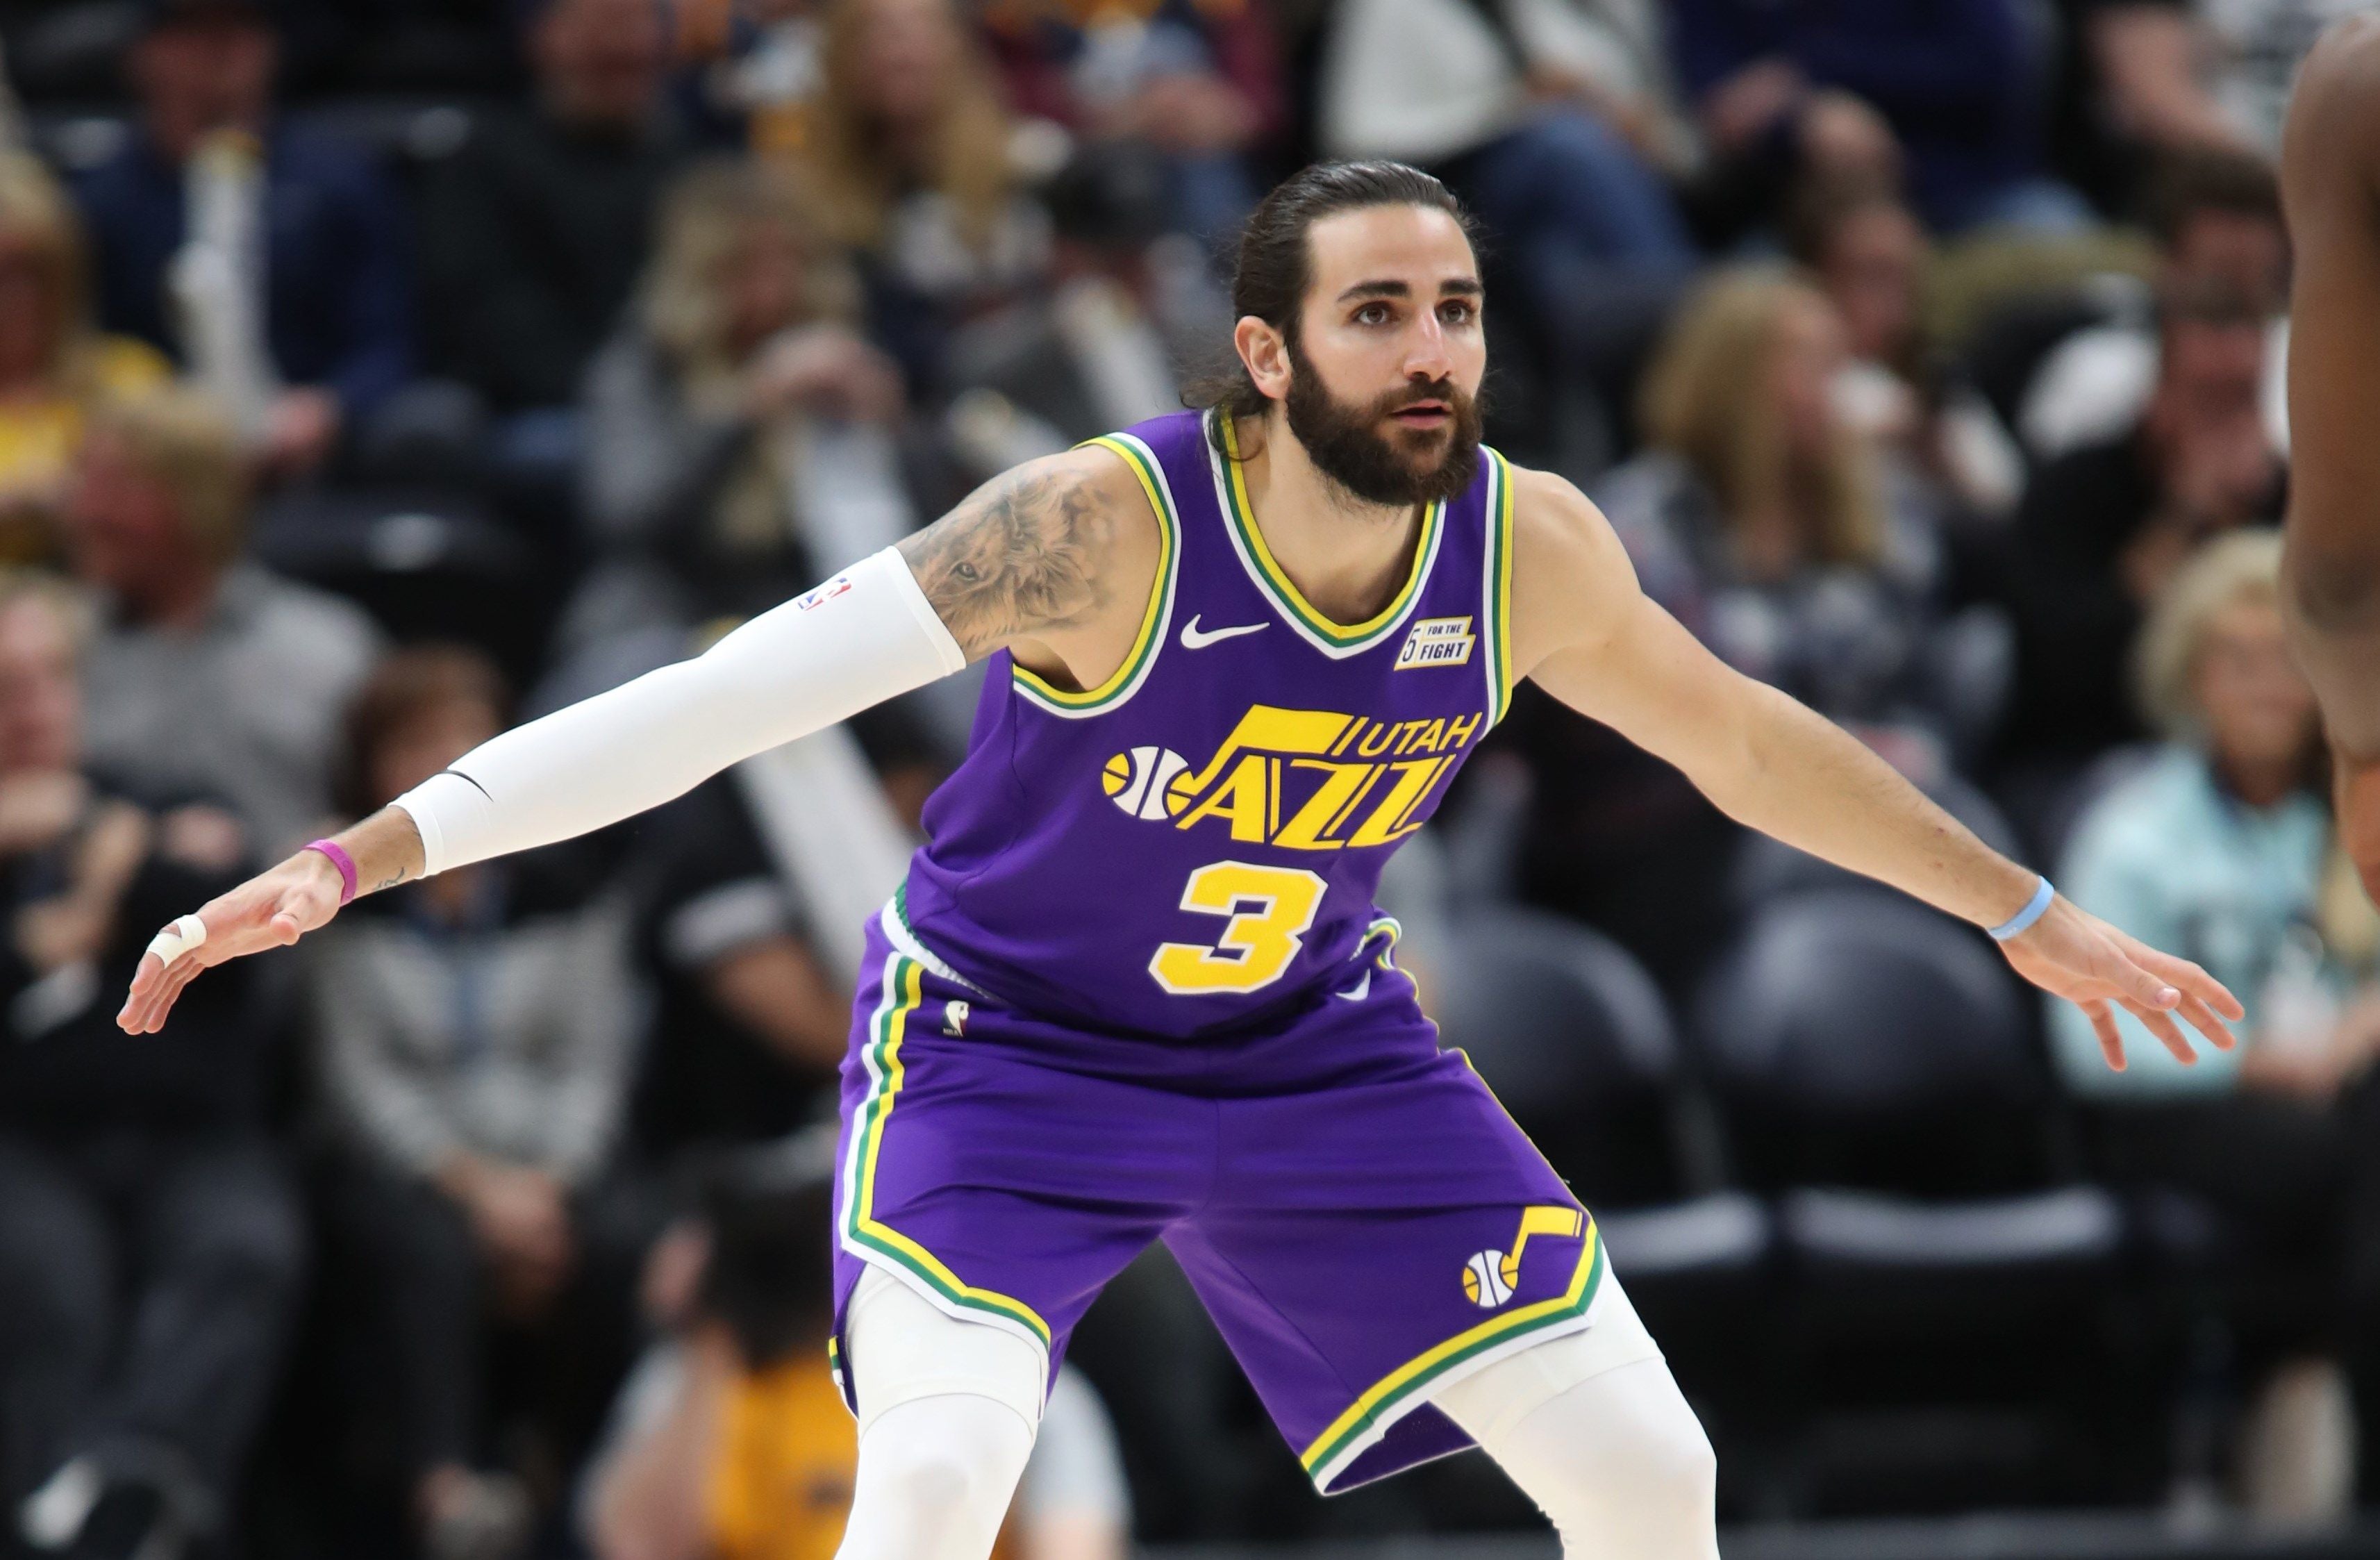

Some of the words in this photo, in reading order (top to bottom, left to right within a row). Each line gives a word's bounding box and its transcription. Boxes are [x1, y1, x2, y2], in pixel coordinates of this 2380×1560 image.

[1402, 628, 1421, 663] 5
[1428, 626, 1442, 636] FOR
[1445, 624, 1463, 633] THE
[1420, 642, 1465, 660] FIGHT
[1362, 713, 1482, 756] UTAH
[1149, 861, 1328, 994] 3
